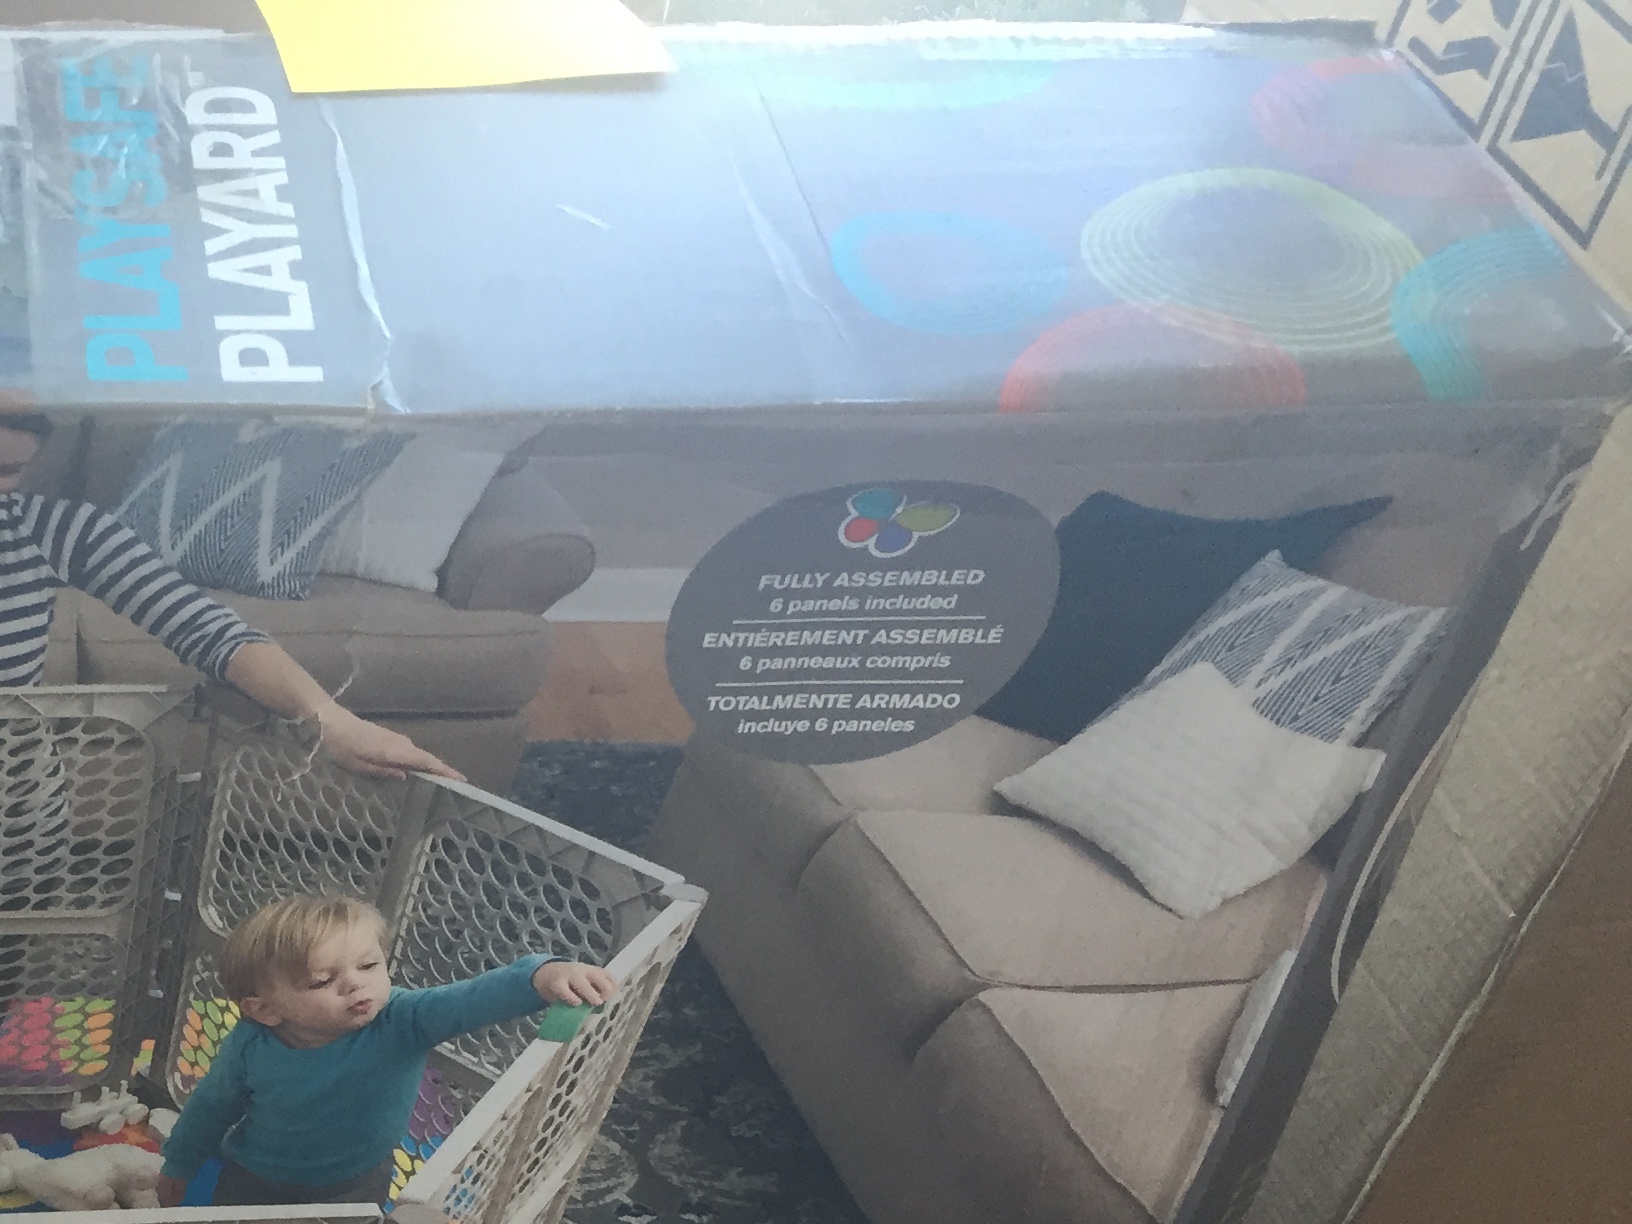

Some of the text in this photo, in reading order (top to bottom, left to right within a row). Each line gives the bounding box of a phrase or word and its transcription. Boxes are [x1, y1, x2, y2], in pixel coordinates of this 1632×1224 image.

[58, 51, 190, 383] PLAYSAFE
[185, 85, 325, 383] PLAYARD
[757, 568, 986, 591] FULLY ASSEMBLED
[768, 593, 959, 615] 6 panels included
[701, 623, 1005, 649] ENTIÈREMENT ASSEMBLÉ
[738, 652, 952, 674] 6 panneaux compris
[706, 693, 962, 712] TOTALMENTE ARMADO
[737, 716, 916, 736] incluye 6 paneles
